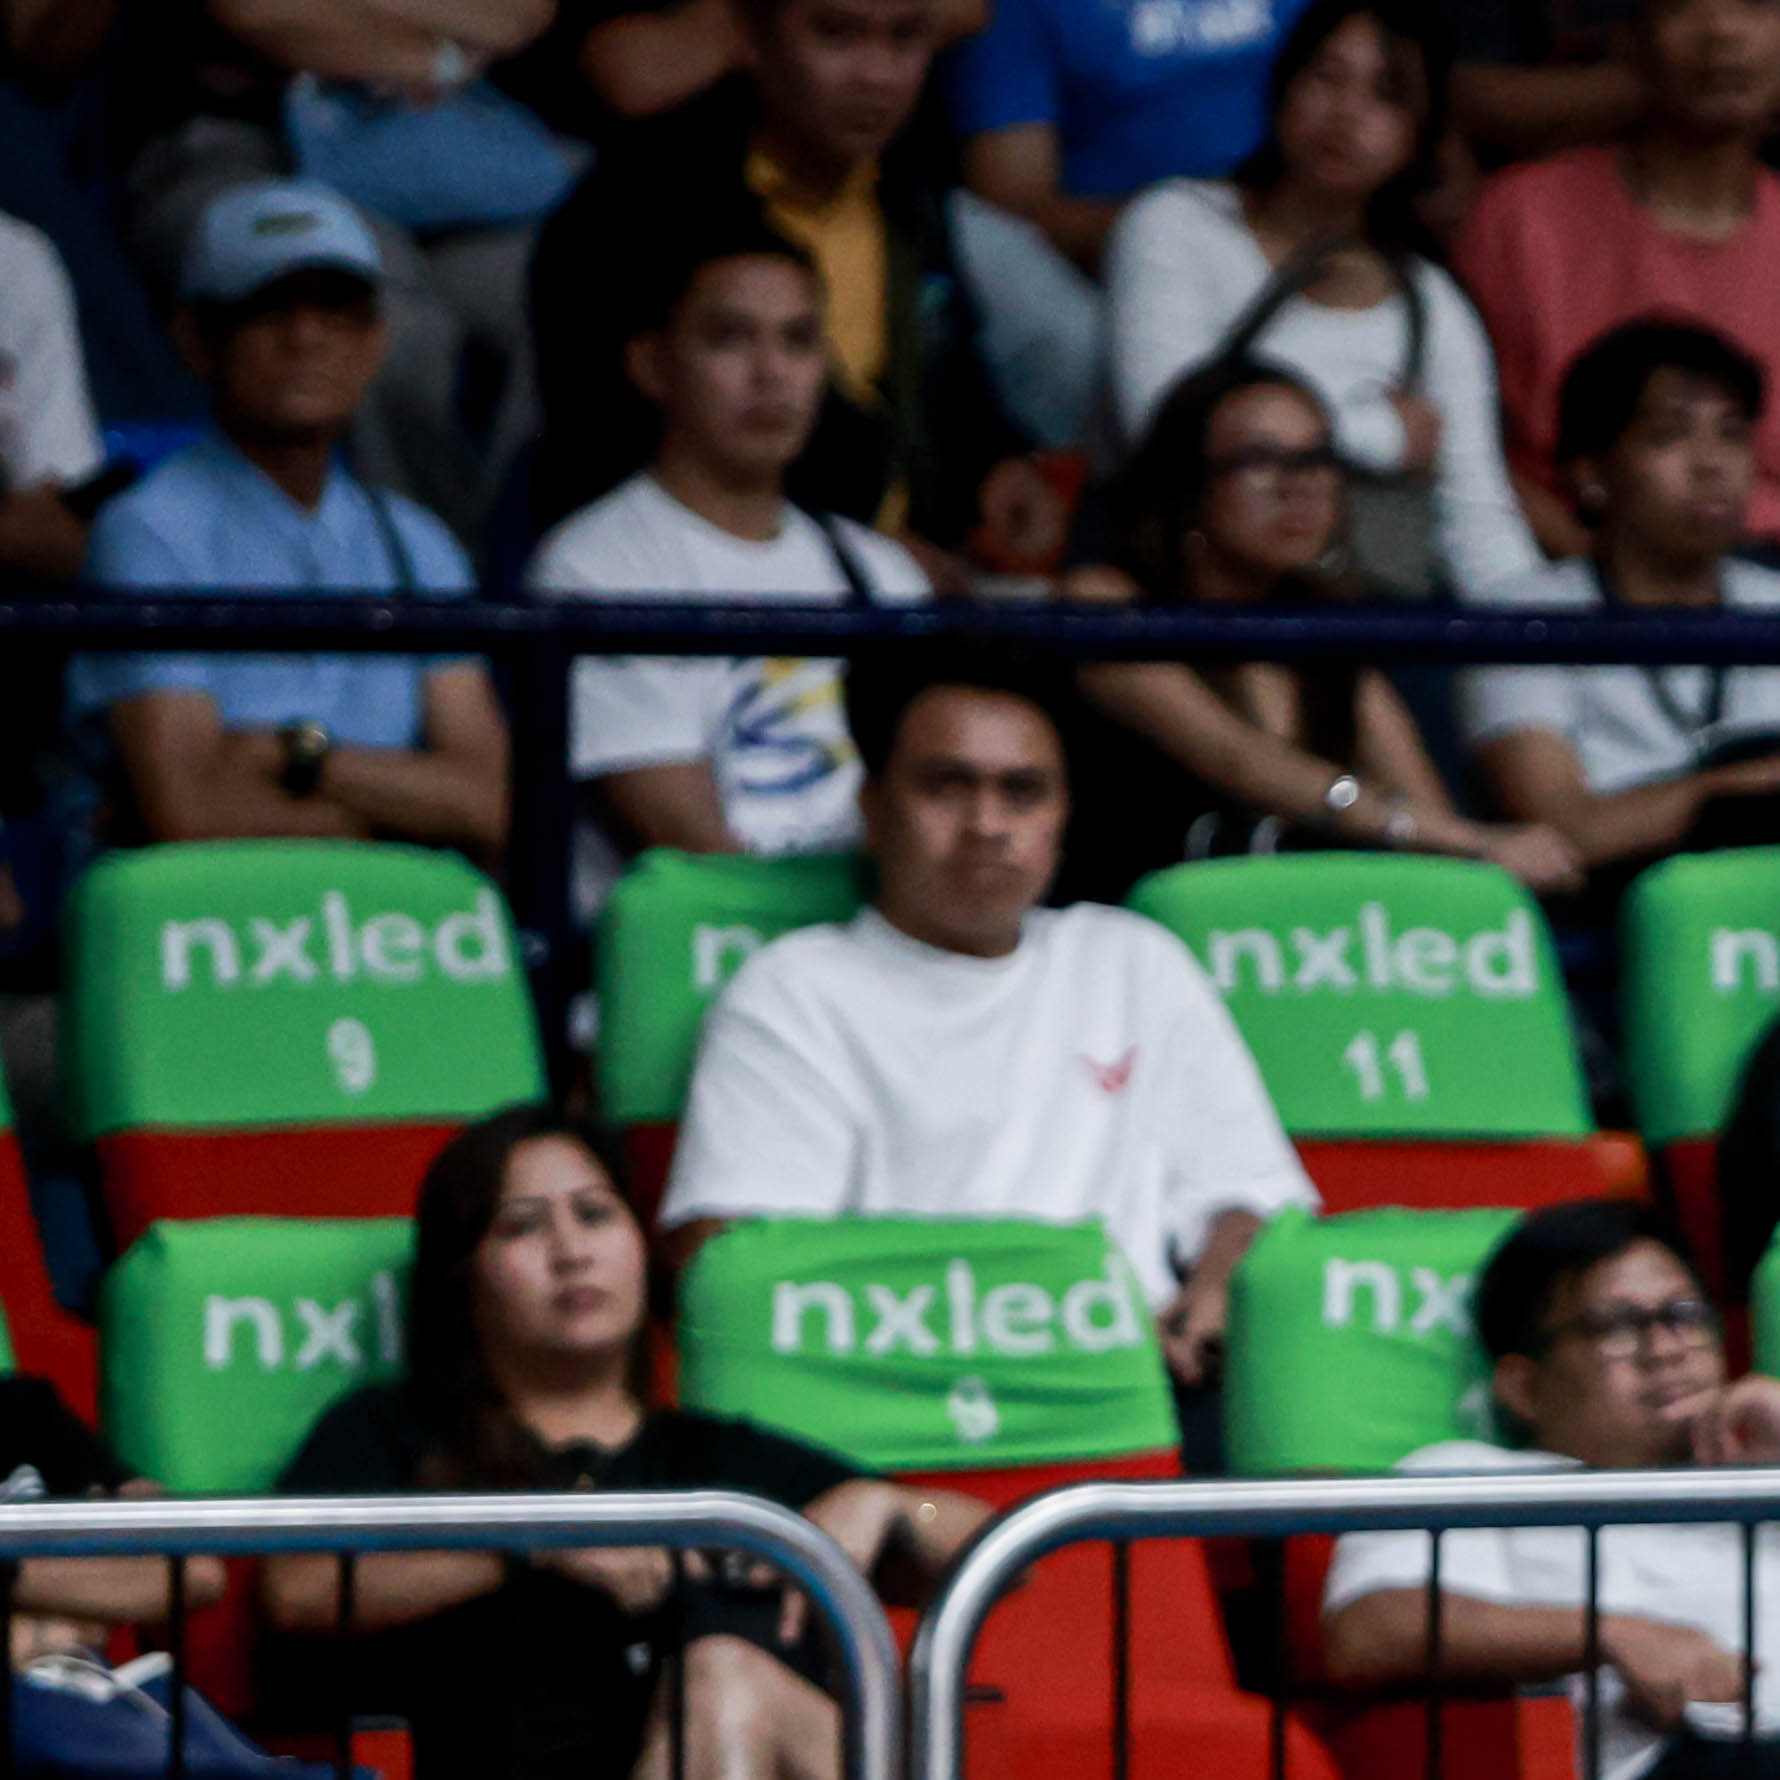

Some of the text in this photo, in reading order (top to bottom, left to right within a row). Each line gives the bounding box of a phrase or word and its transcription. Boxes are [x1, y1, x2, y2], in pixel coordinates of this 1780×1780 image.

[161, 887, 510, 990] nxled
[1206, 902, 1539, 996] nxled
[1341, 1029, 1431, 1102] 11
[203, 1270, 402, 1372] nxl
[770, 1251, 1145, 1357] nxled
